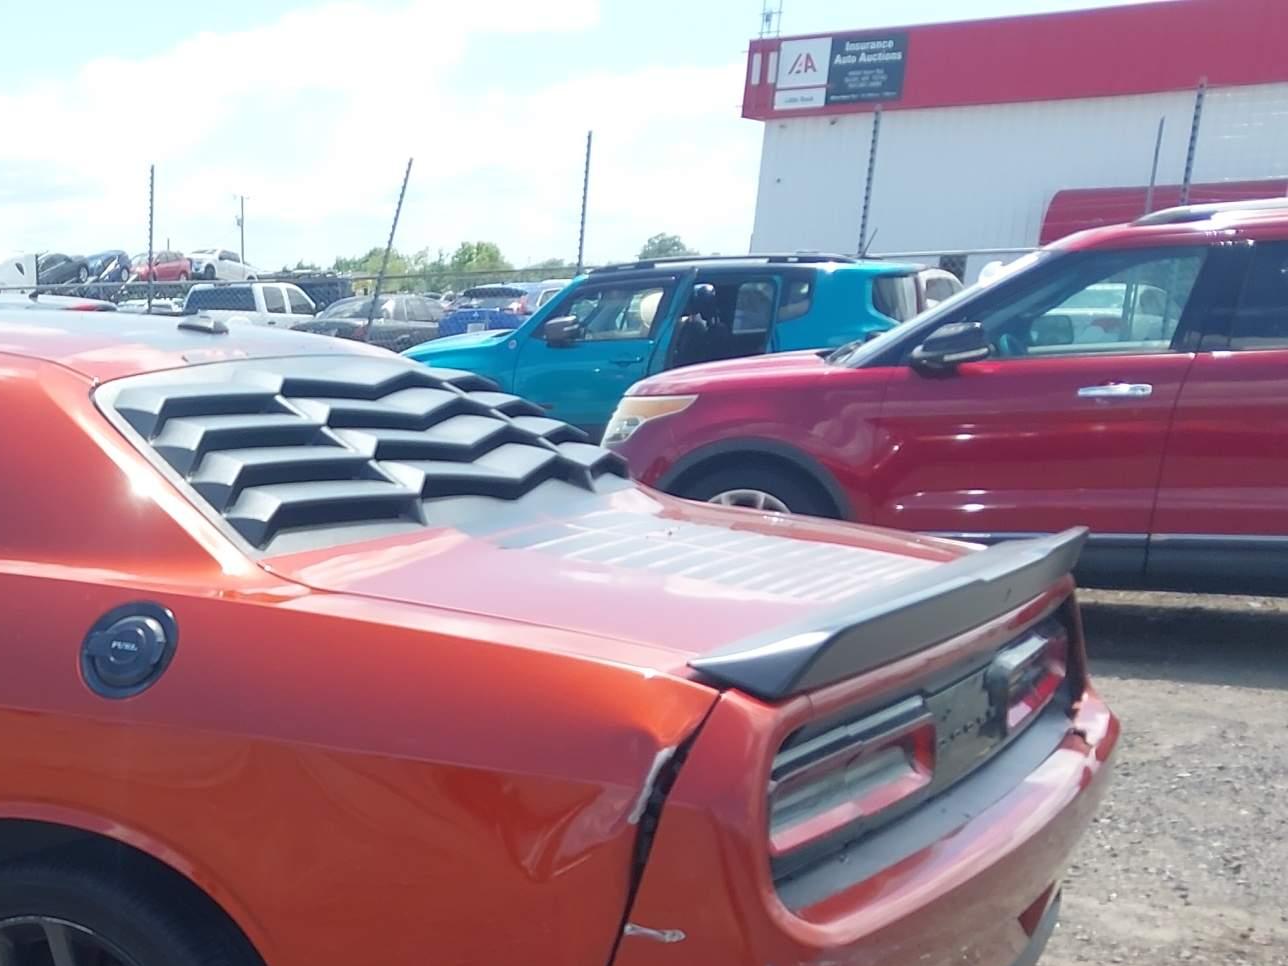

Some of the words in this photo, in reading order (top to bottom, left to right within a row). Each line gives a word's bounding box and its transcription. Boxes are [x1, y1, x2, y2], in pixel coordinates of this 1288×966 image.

[845, 40, 894, 51] Insurance
[834, 54, 857, 64] Auto
[859, 51, 902, 63] Auctions
